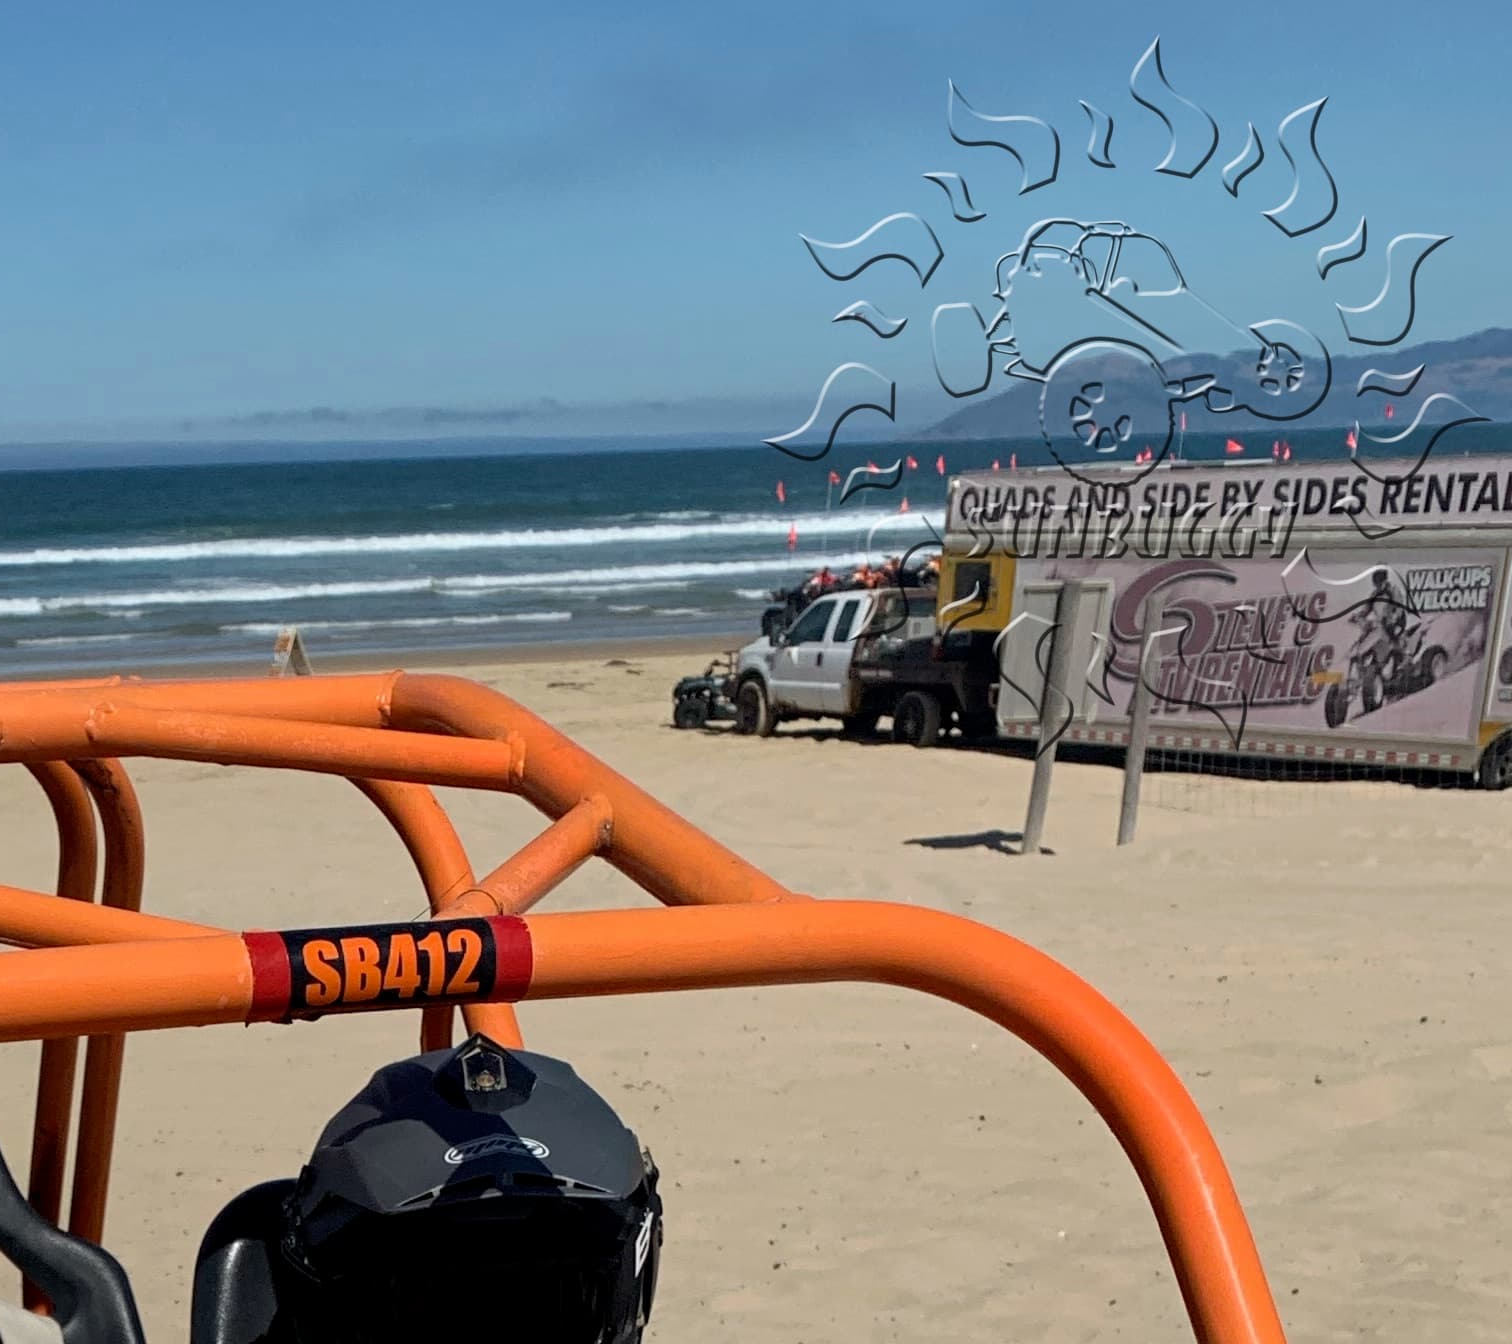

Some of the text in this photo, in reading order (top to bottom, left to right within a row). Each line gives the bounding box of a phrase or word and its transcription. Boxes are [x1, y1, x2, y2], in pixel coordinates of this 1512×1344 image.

[960, 485, 1056, 521] QUADS
[1064, 484, 1131, 519] AND
[1142, 482, 1210, 518] SIDE
[1221, 480, 1264, 517] BY
[1273, 477, 1368, 516] SIDES
[1407, 566, 1492, 589] WALK-UPS
[1407, 588, 1487, 612] WELCOME
[302, 929, 483, 1005] SB412
